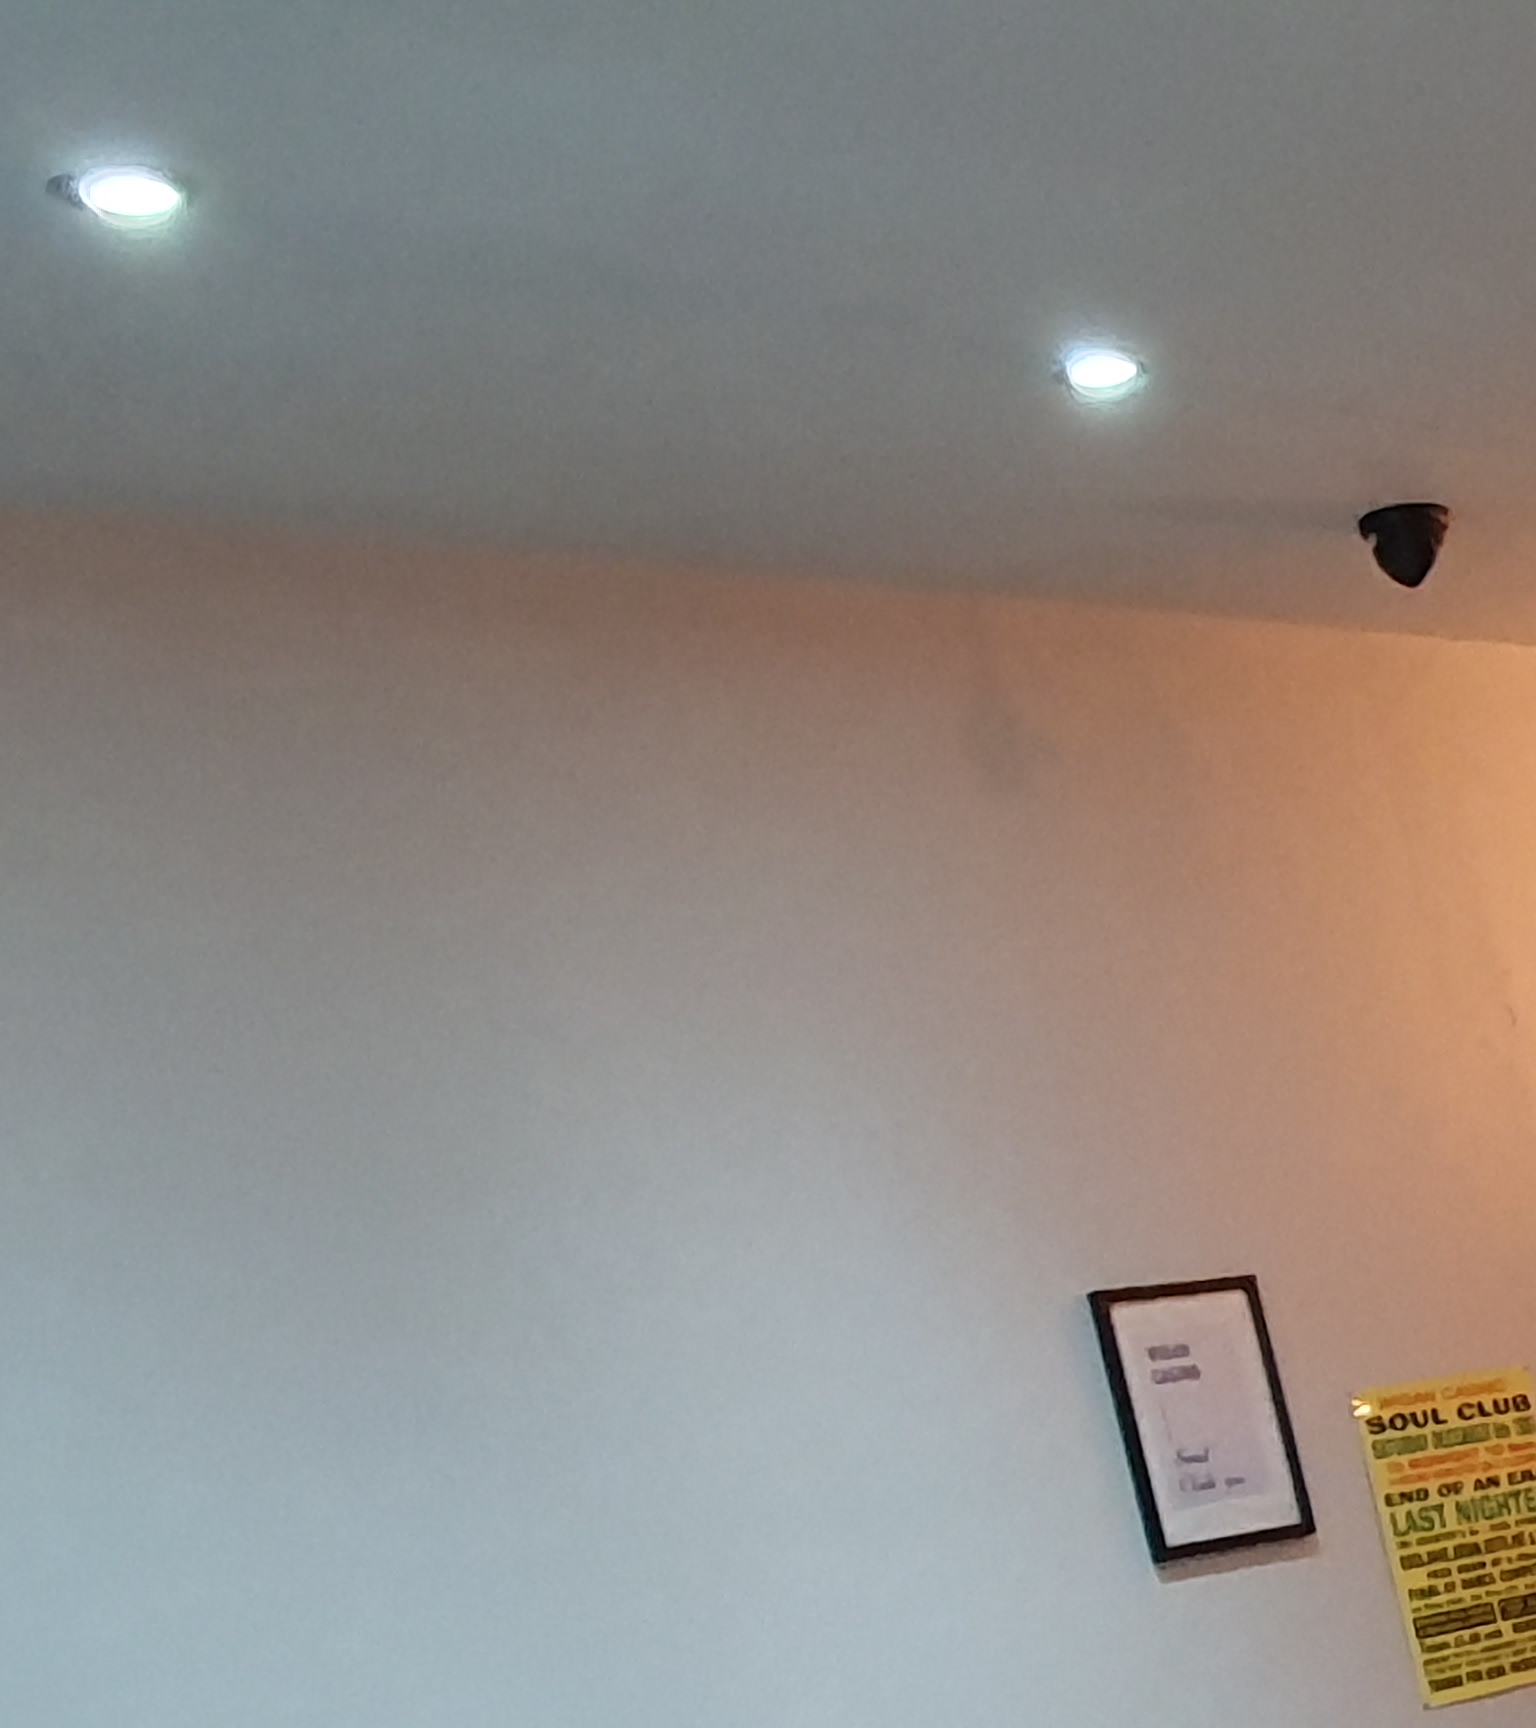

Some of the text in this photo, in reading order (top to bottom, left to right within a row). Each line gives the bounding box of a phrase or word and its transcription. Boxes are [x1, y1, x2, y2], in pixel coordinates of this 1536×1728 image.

[1365, 1394, 1532, 1434] SOUL CLUB
[1384, 1488, 1429, 1507] END
[1437, 1481, 1464, 1497] OF
[1473, 1475, 1501, 1491] AN
[1389, 1503, 1447, 1537] LAST
